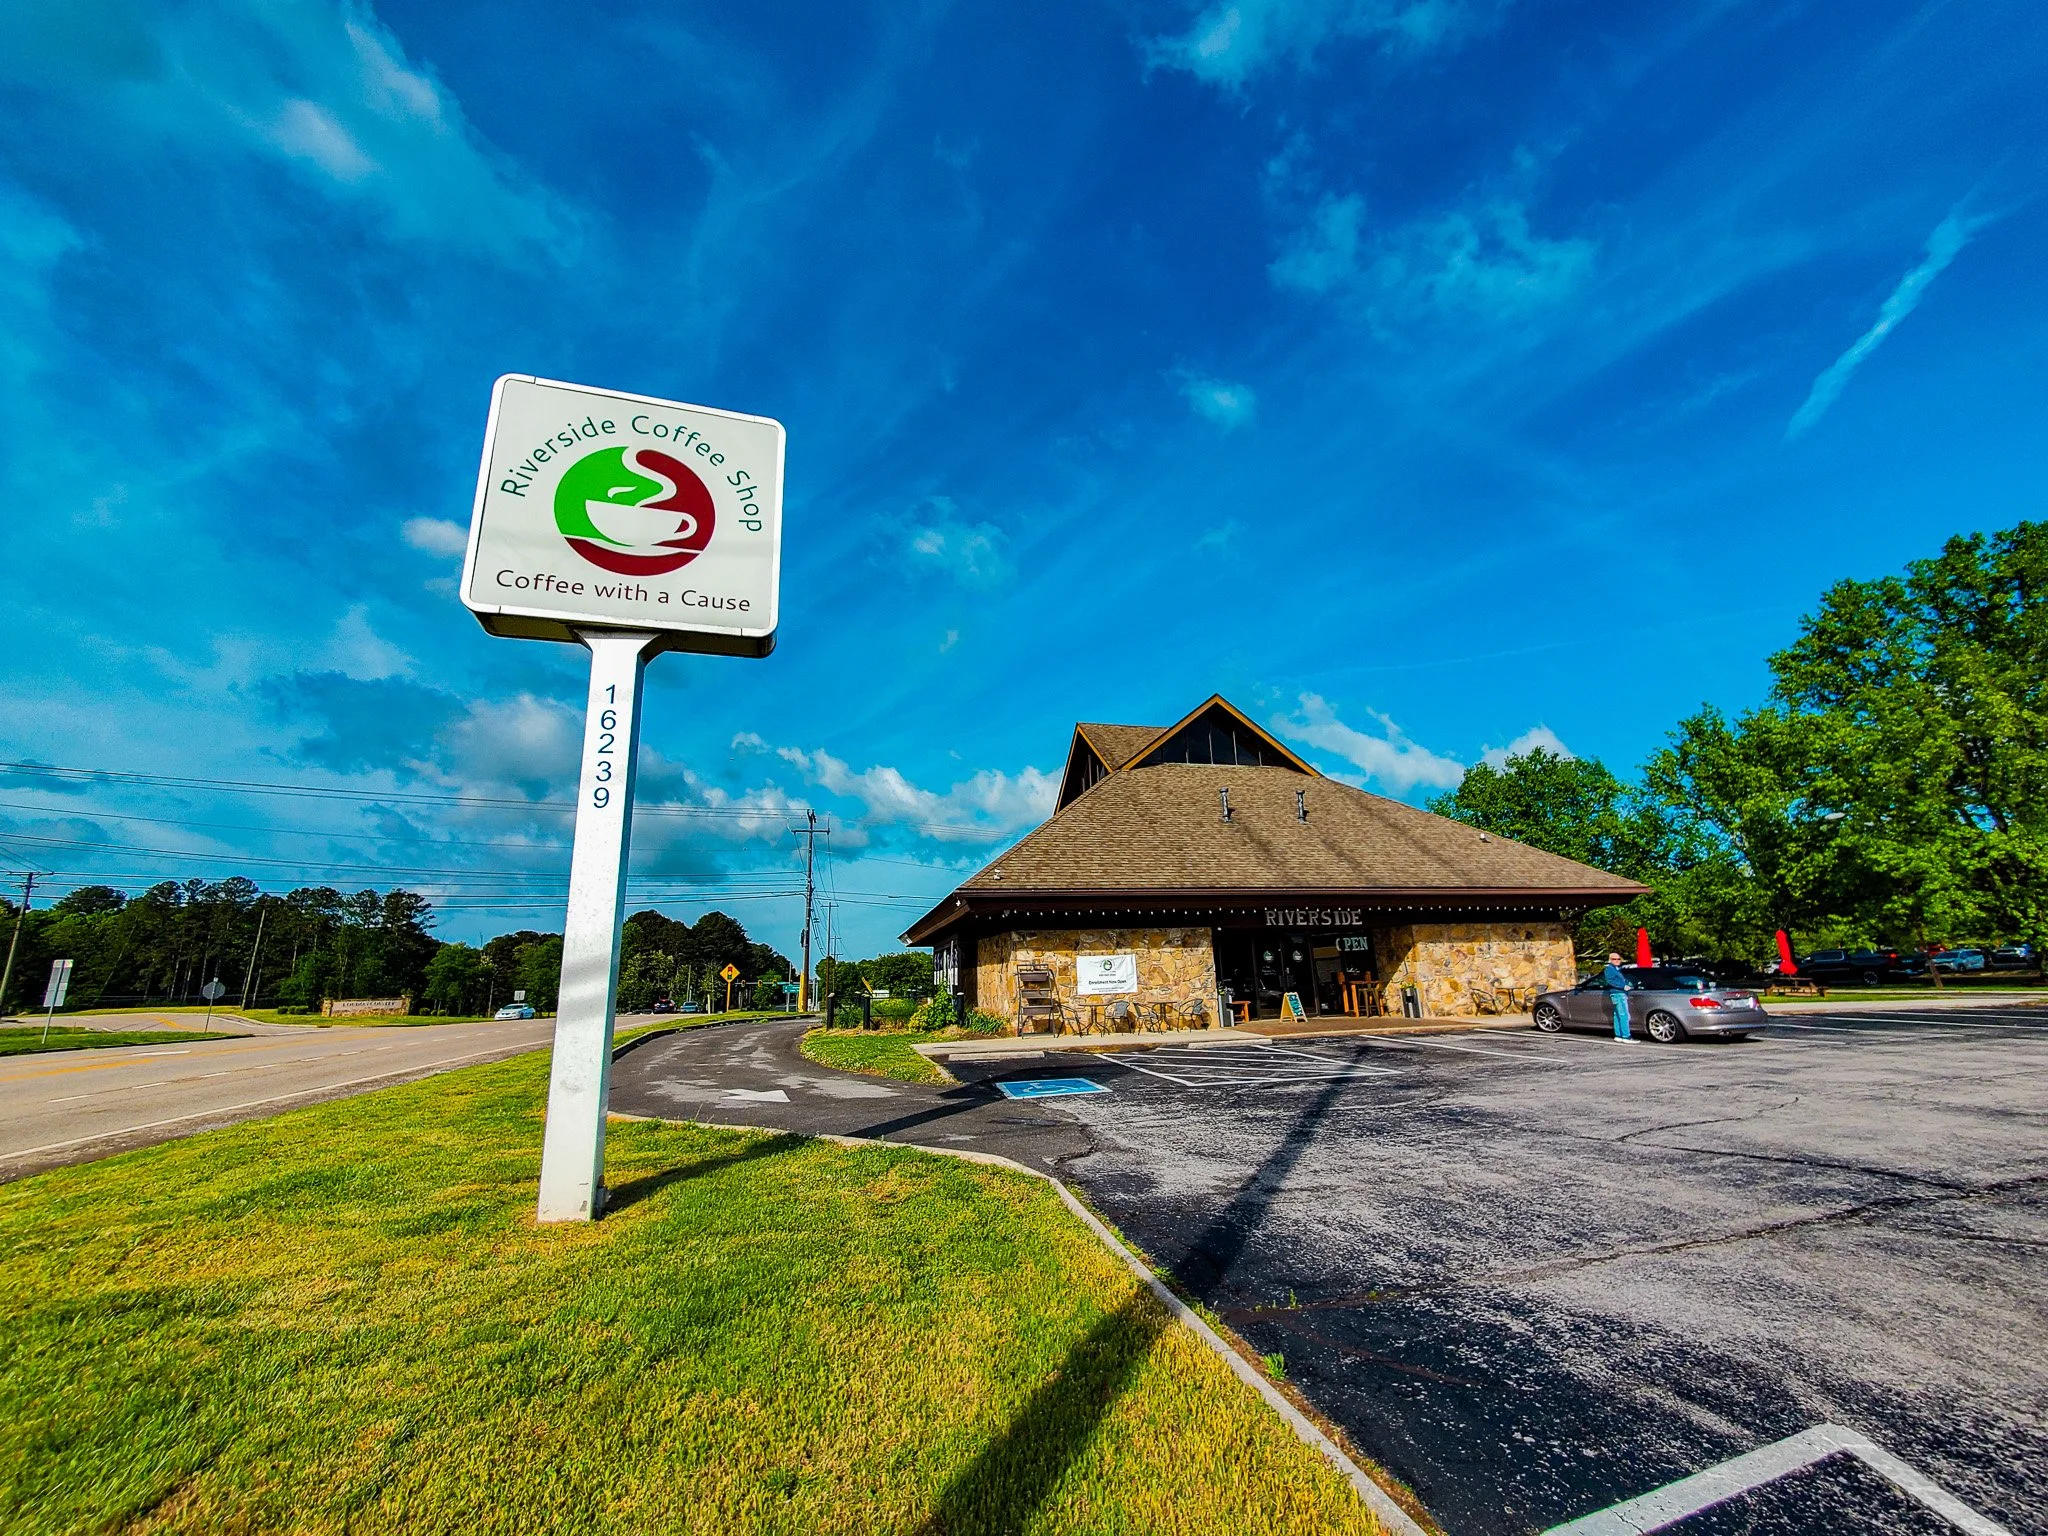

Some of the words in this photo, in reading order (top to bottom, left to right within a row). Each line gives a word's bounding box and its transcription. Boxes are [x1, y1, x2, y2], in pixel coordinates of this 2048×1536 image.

[500, 416, 616, 498] Riverside
[631, 415, 726, 467] Coffee
[726, 469, 762, 532] Shop
[496, 569, 585, 595] Coffee
[594, 583, 648, 602] with
[658, 591, 670, 604] a
[681, 589, 751, 612] Cause
[593, 684, 617, 808] 16239
[1265, 910, 1363, 926] RIVERSIDE
